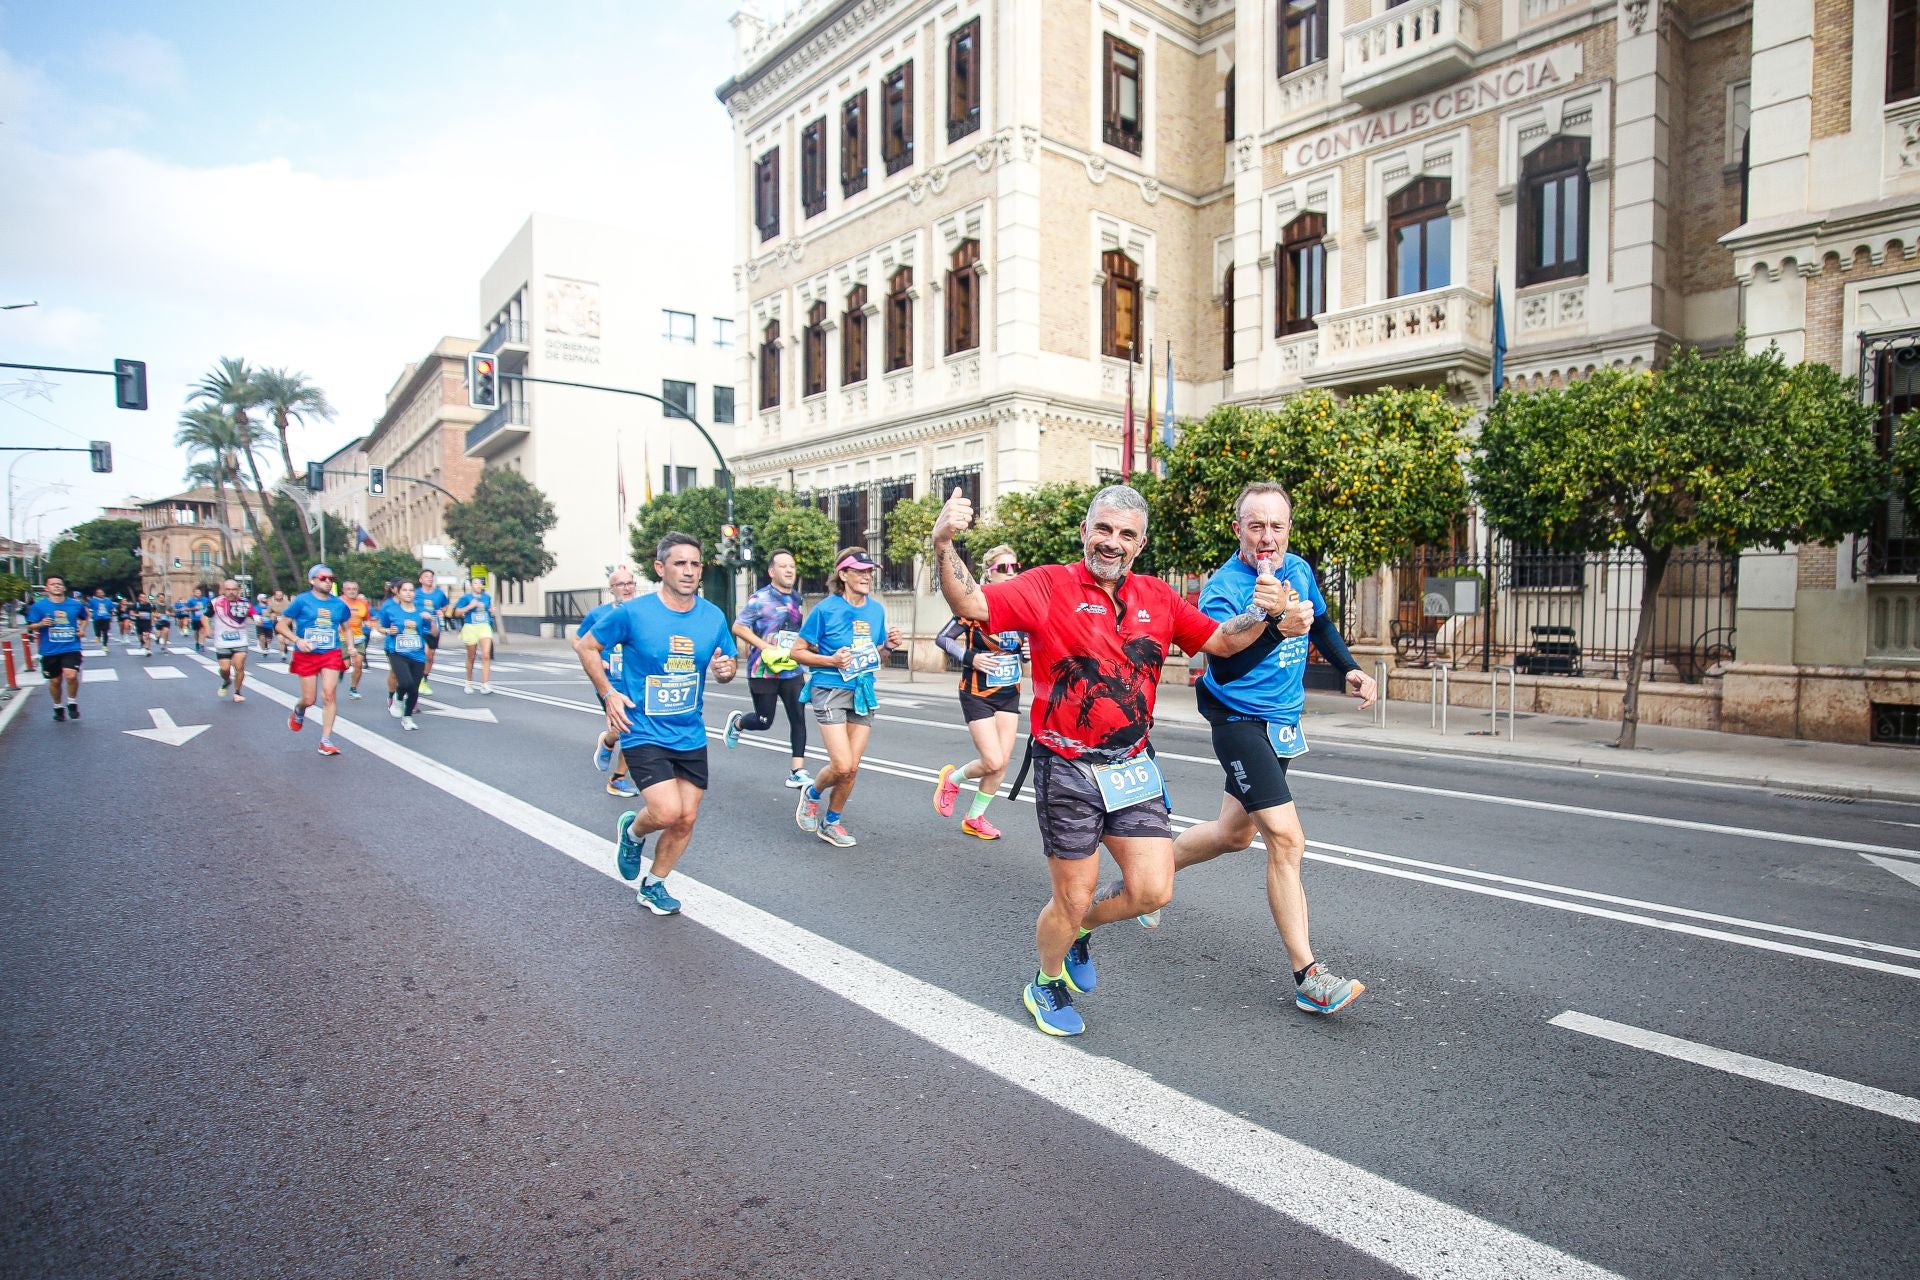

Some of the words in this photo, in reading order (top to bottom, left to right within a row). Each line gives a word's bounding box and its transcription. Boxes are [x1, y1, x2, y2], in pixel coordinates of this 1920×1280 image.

[1296, 56, 1560, 167] CONVALECENCIA
[845, 653, 878, 671] 126
[657, 687, 691, 703] 937
[1109, 765, 1149, 790] 916
[1230, 760, 1251, 794] FILA
